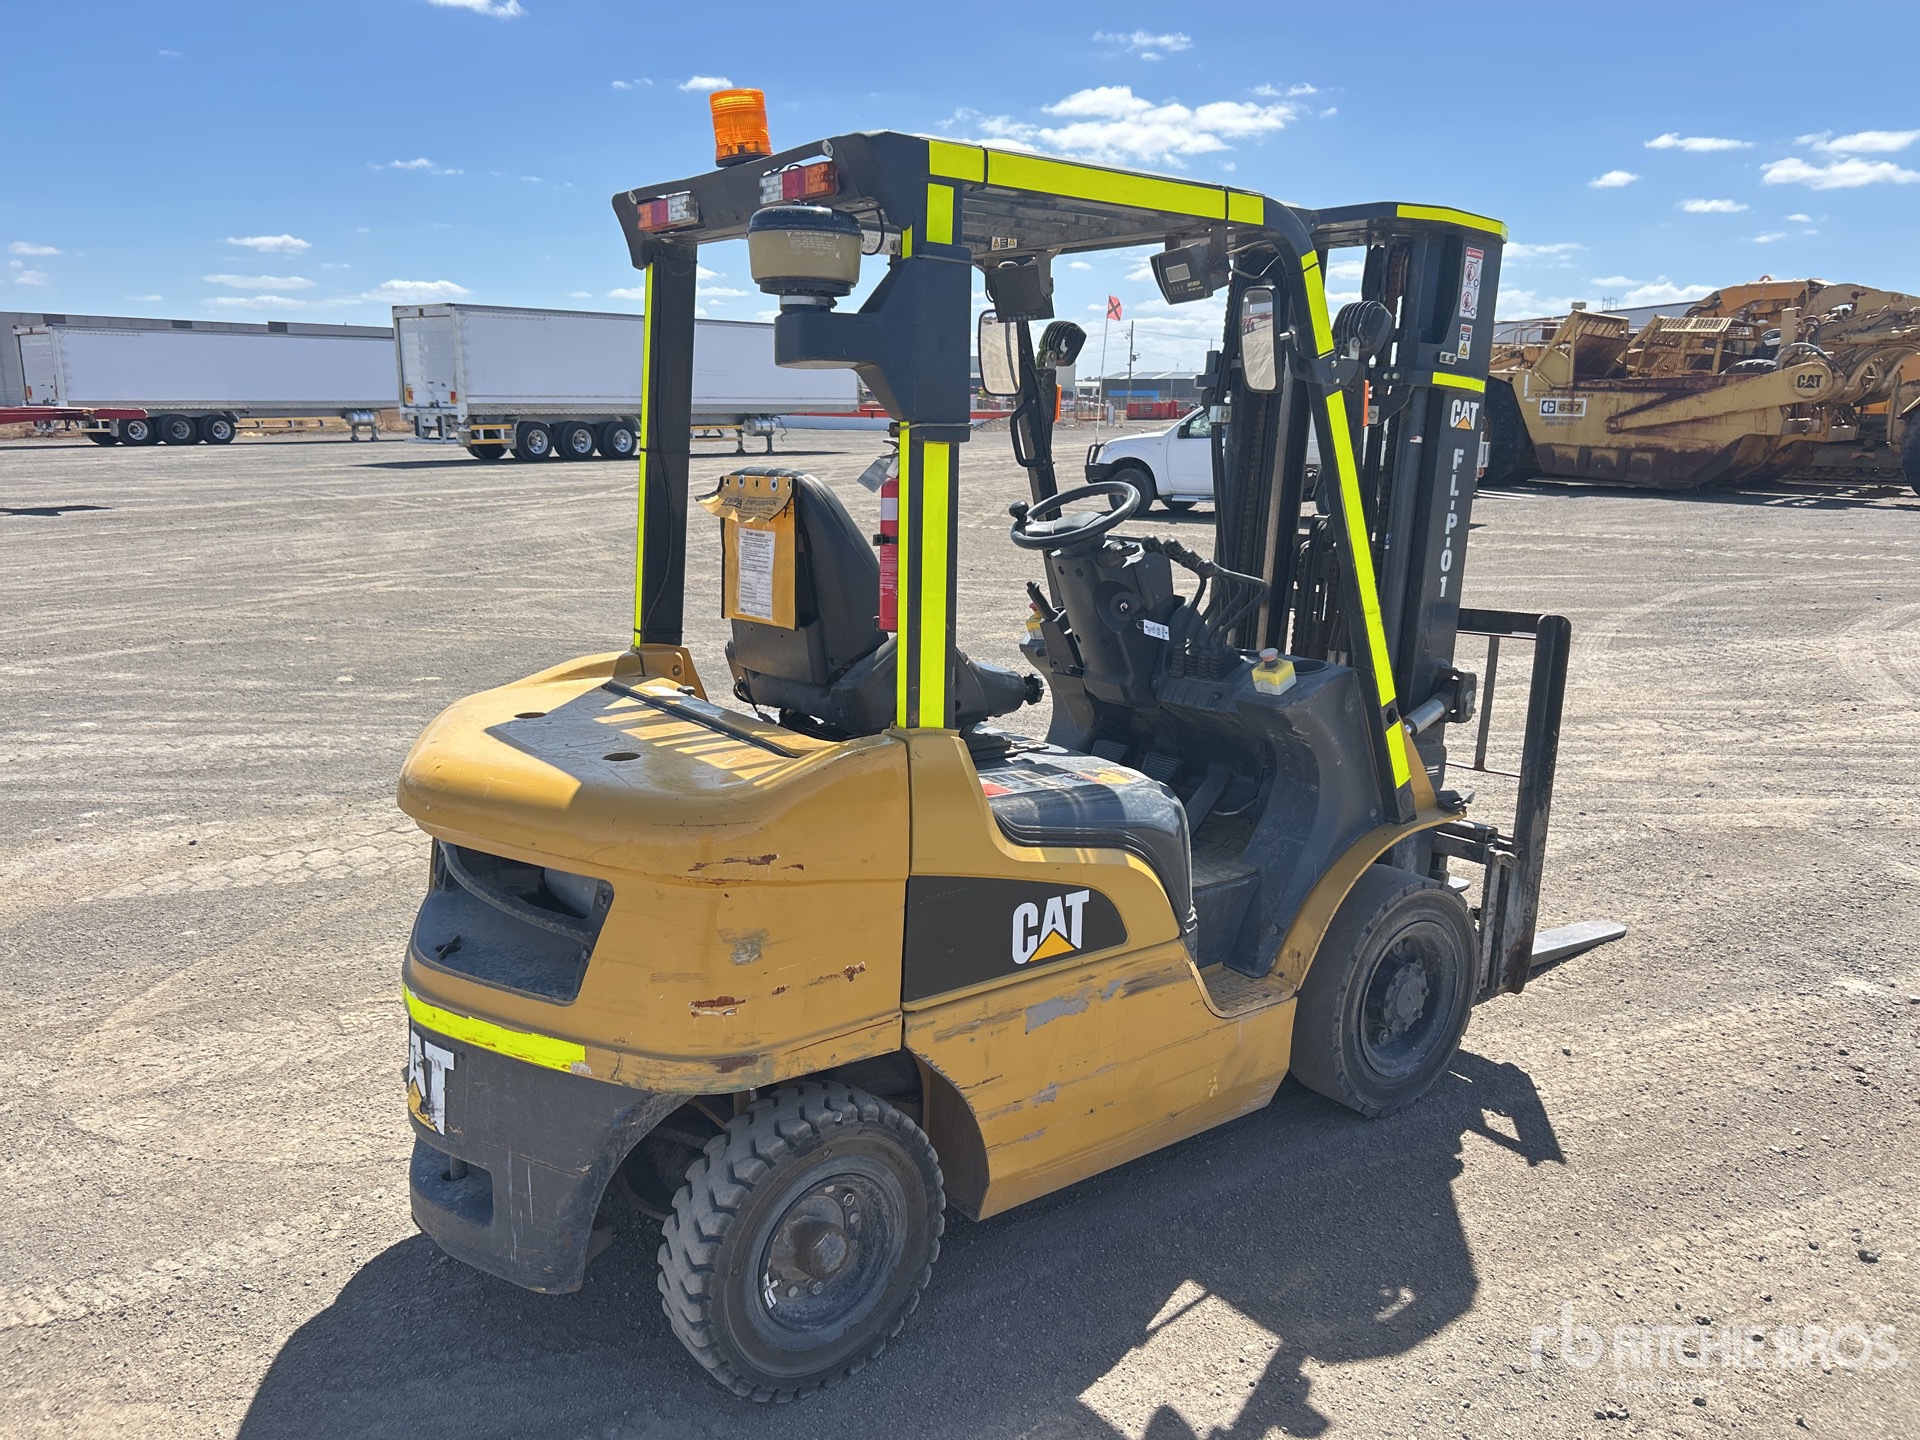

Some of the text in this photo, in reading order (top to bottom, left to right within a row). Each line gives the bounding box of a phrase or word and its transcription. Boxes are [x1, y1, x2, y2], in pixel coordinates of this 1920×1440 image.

[1797, 375, 1823, 388] CAT
[1450, 399, 1480, 430] CAT
[1558, 403, 1582, 412] 637
[1012, 889, 1090, 965] CAT
